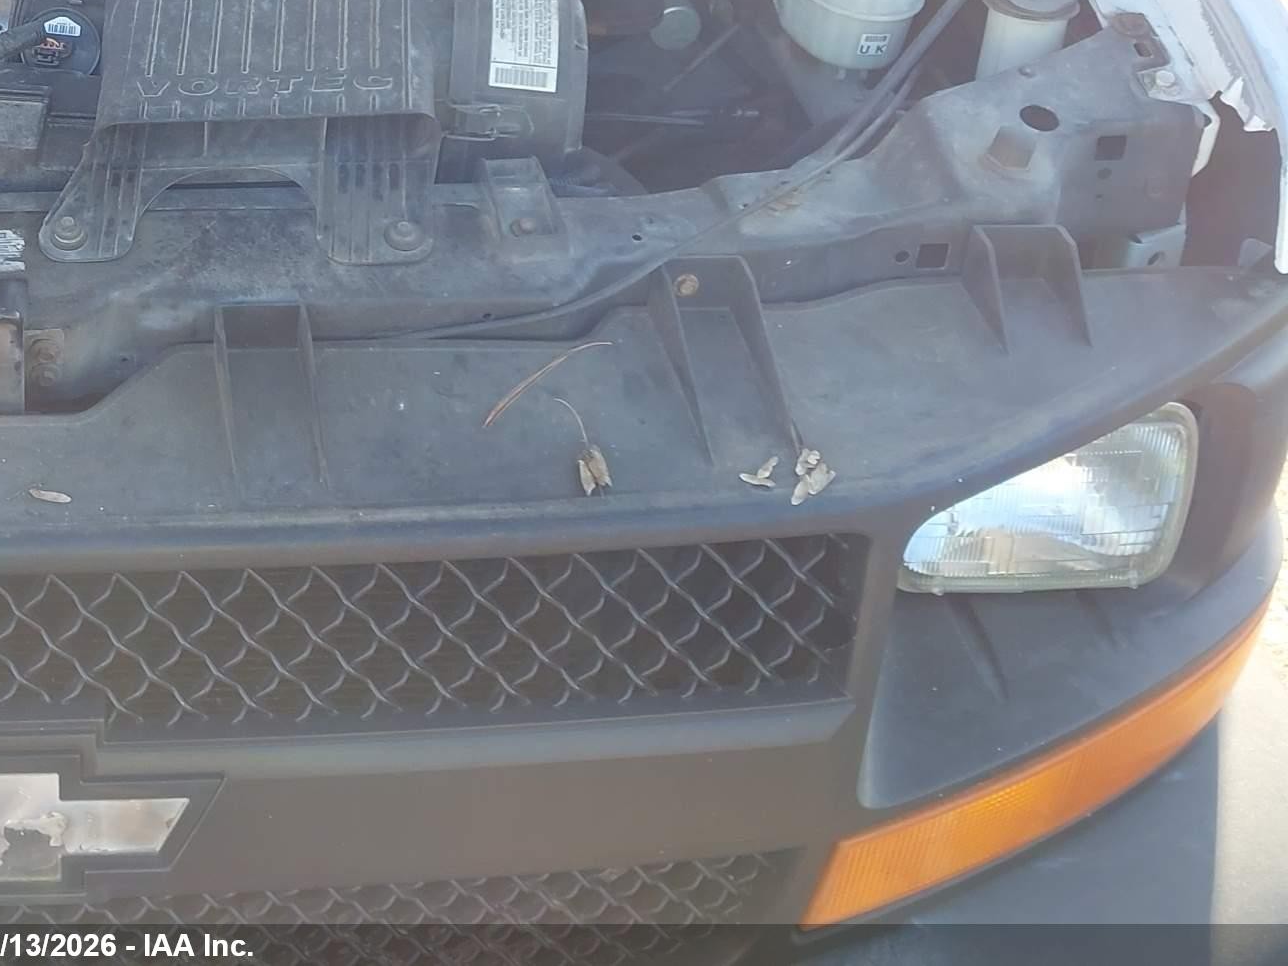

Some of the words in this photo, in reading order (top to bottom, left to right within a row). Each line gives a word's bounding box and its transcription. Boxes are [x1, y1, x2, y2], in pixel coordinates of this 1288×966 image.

[859, 44, 871, 55] U
[874, 44, 887, 55] K
[135, 74, 394, 98] VORTEC
